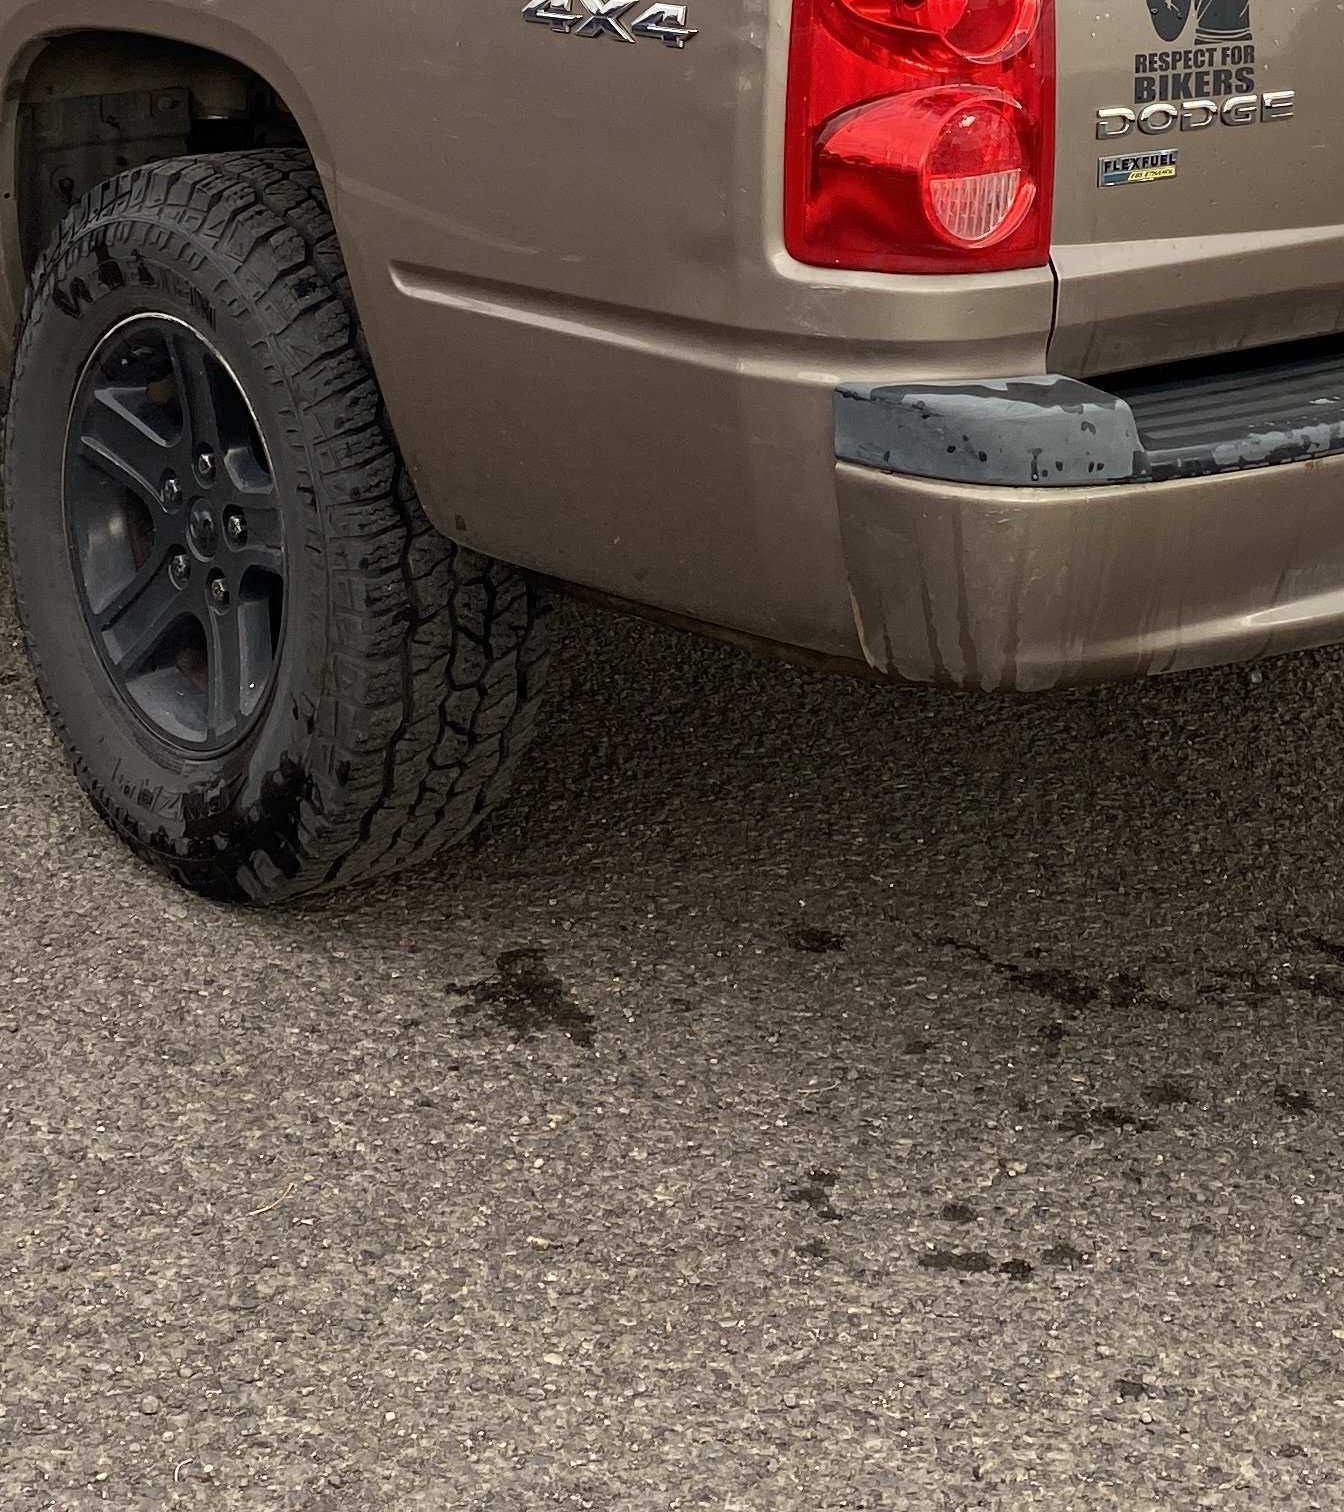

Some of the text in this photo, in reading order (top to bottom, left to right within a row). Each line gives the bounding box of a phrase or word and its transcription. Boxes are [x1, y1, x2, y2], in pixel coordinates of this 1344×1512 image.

[1134, 44, 1255, 74] RESPECT FOR
[1134, 66, 1255, 104] BIKERS
[1096, 90, 1296, 140] DODGE
